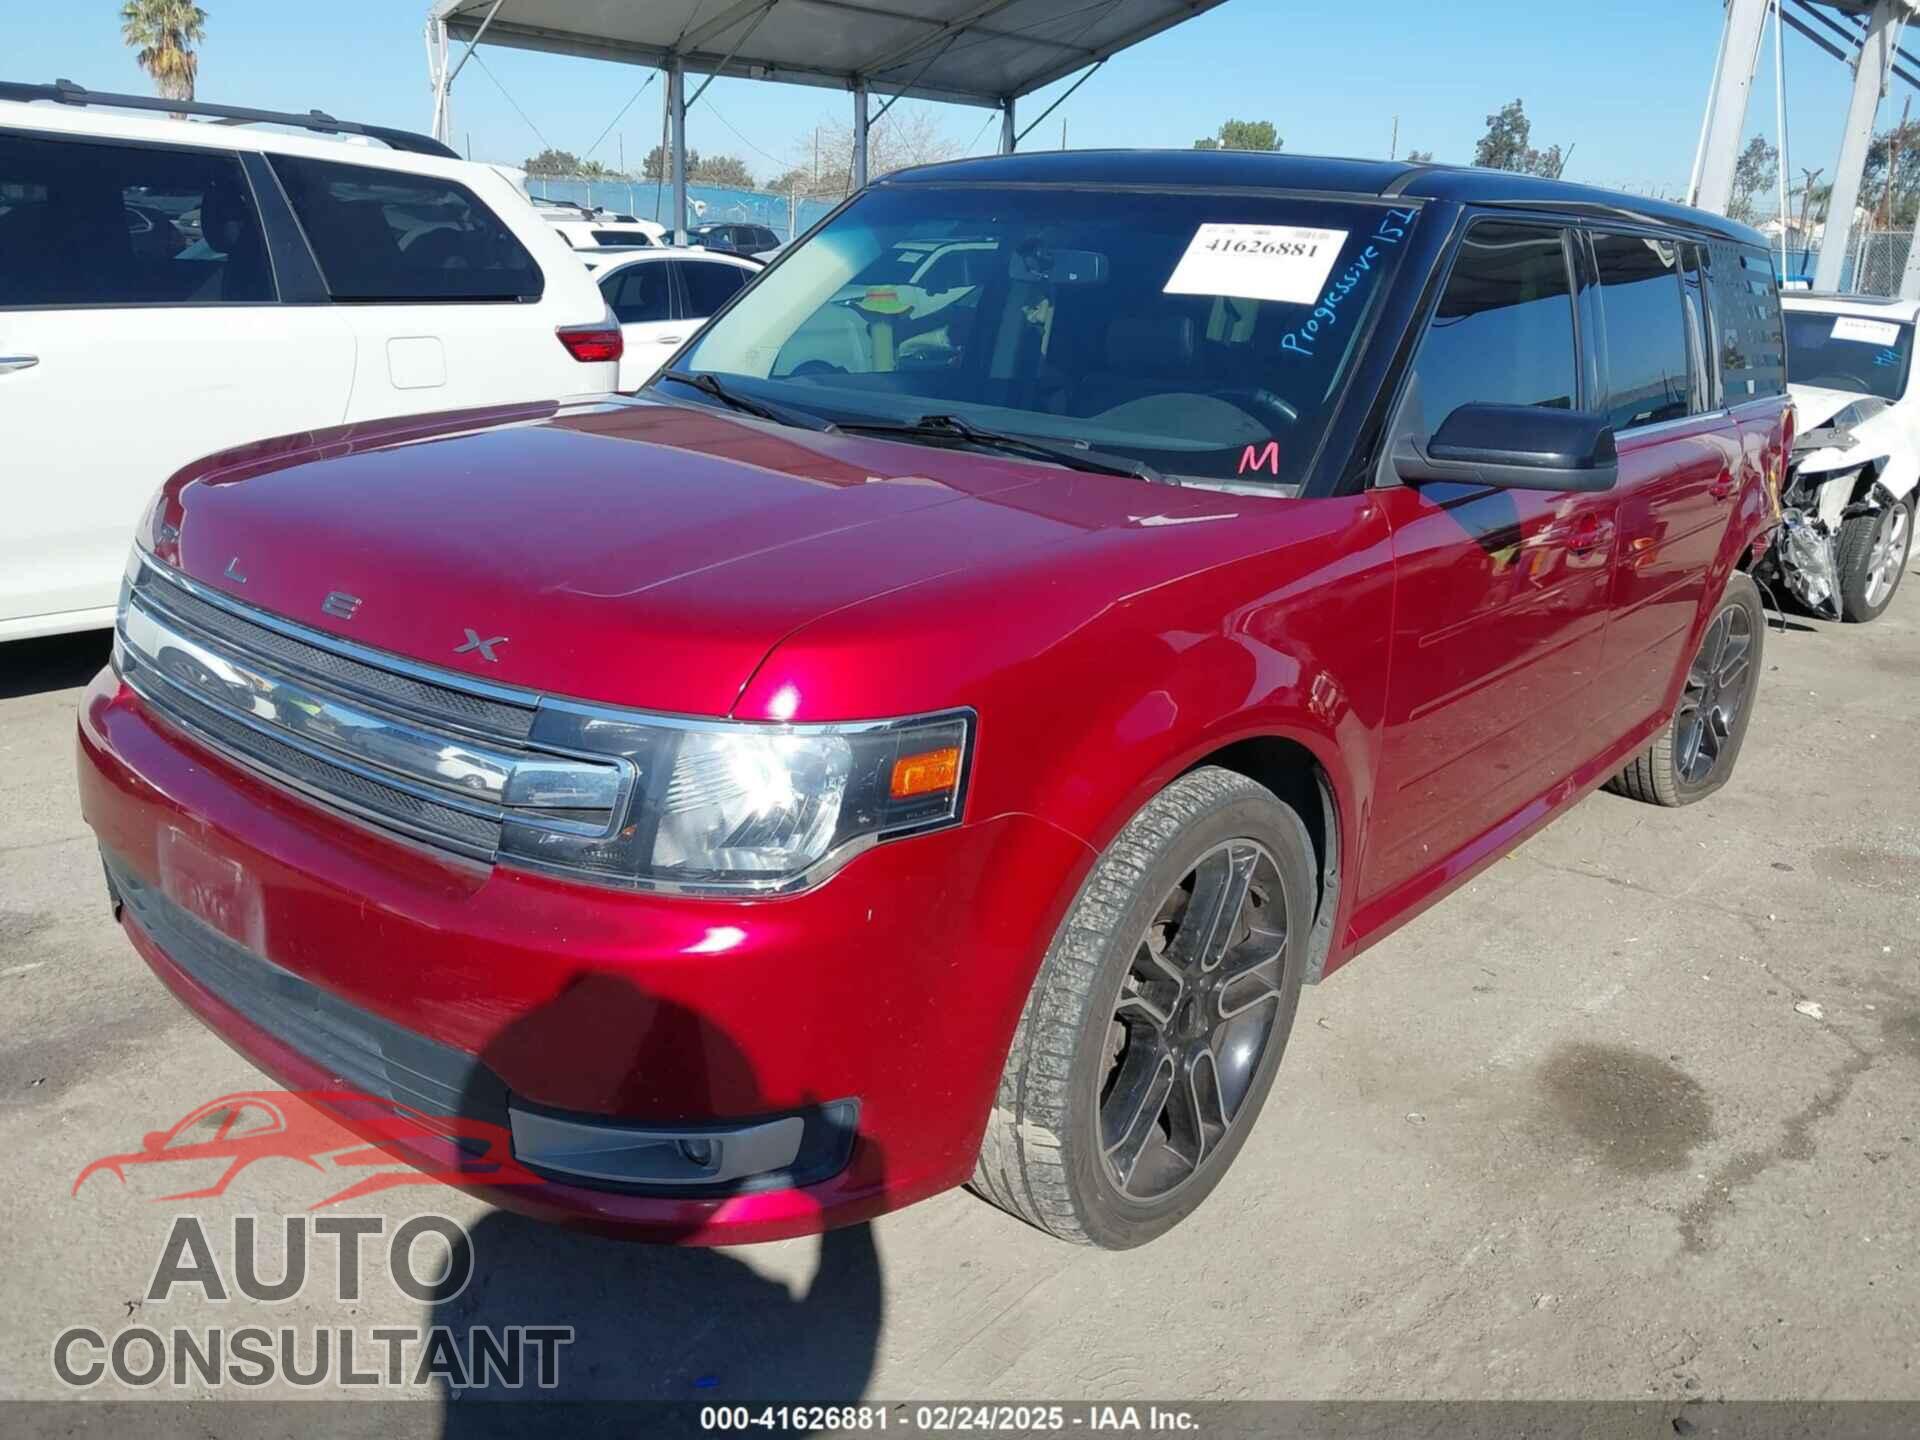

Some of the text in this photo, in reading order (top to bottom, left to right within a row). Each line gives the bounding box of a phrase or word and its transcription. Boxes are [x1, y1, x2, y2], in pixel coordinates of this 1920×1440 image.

[1205, 238, 1318, 258] 41626881
[1281, 245, 1379, 356] Progressive
[1238, 441, 1279, 475] M
